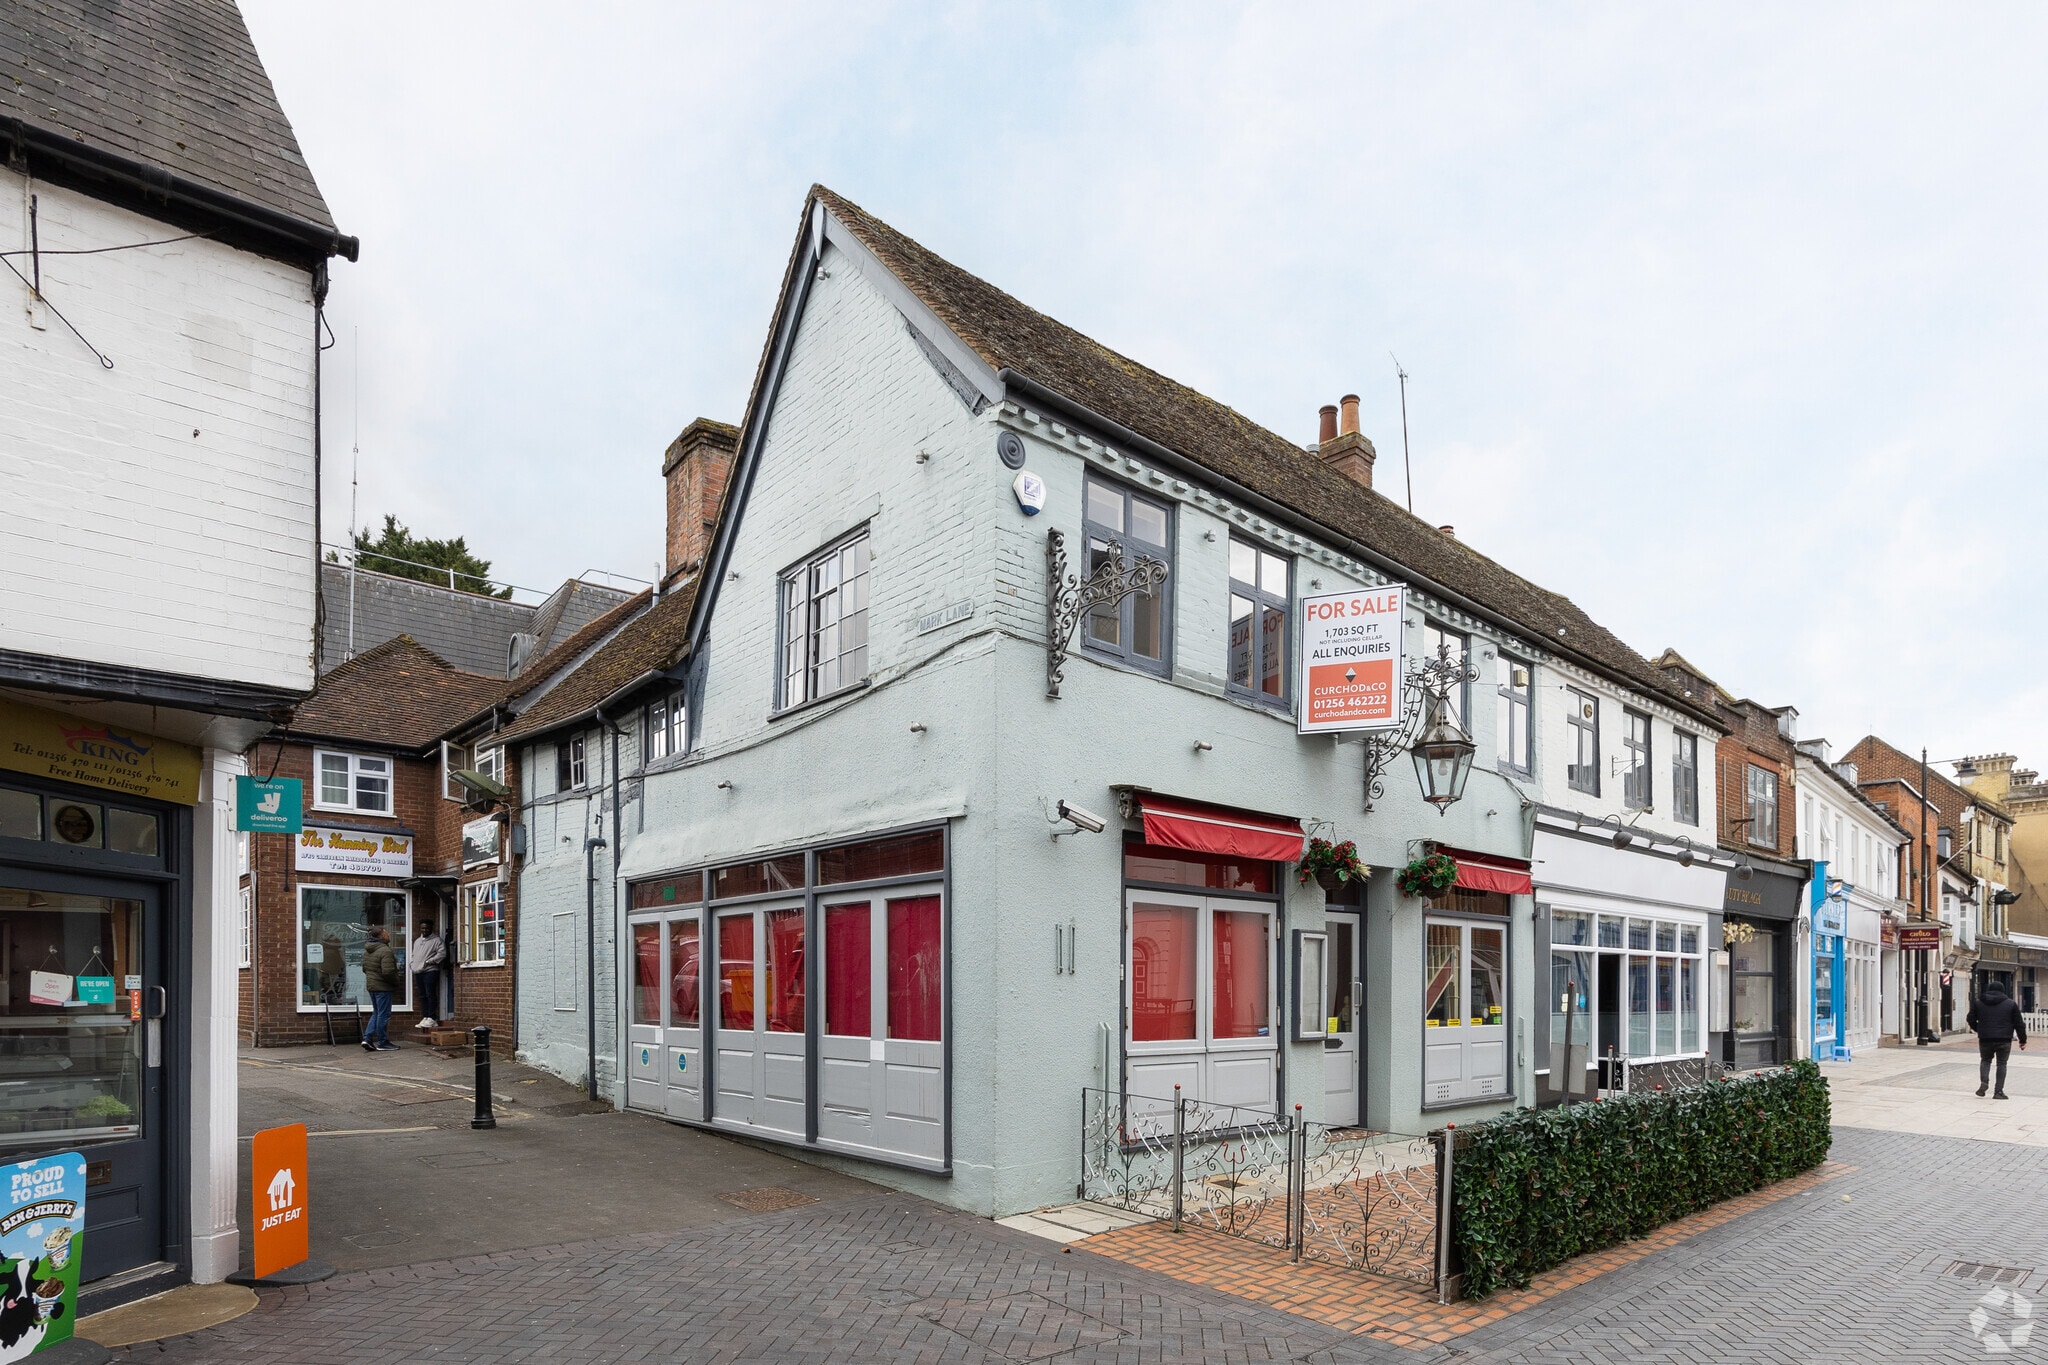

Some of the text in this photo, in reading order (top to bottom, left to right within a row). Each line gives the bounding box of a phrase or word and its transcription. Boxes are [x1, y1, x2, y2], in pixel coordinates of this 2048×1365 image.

[920, 602, 971, 631] MARK LANE
[1307, 594, 1398, 621] FOR SALE
[1325, 624, 1379, 638] 1,703 SQ FT
[1312, 642, 1391, 659] ALL ENQUIRIES
[1314, 682, 1387, 696] CURCHOD&CO
[1313, 694, 1387, 709] 01256 462222
[1314, 707, 1386, 718] curchodandco.com
[13, 742, 34, 755] Tel:
[37, 750, 67, 763] 01256
[70, 757, 89, 767] 470
[145, 774, 162, 783] 470
[165, 778, 180, 787] 741
[80, 740, 139, 766] KING
[48, 765, 151, 795] Free Home Delivery
[250, 814, 288, 822] deliveroo
[301, 829, 409, 858] The Humming Bird
[44, 982, 60, 990] Open
[11, 1165, 65, 1190] PROUD
[10, 1180, 65, 1204] TO SELL
[261, 1207, 302, 1232] JUST EAT
